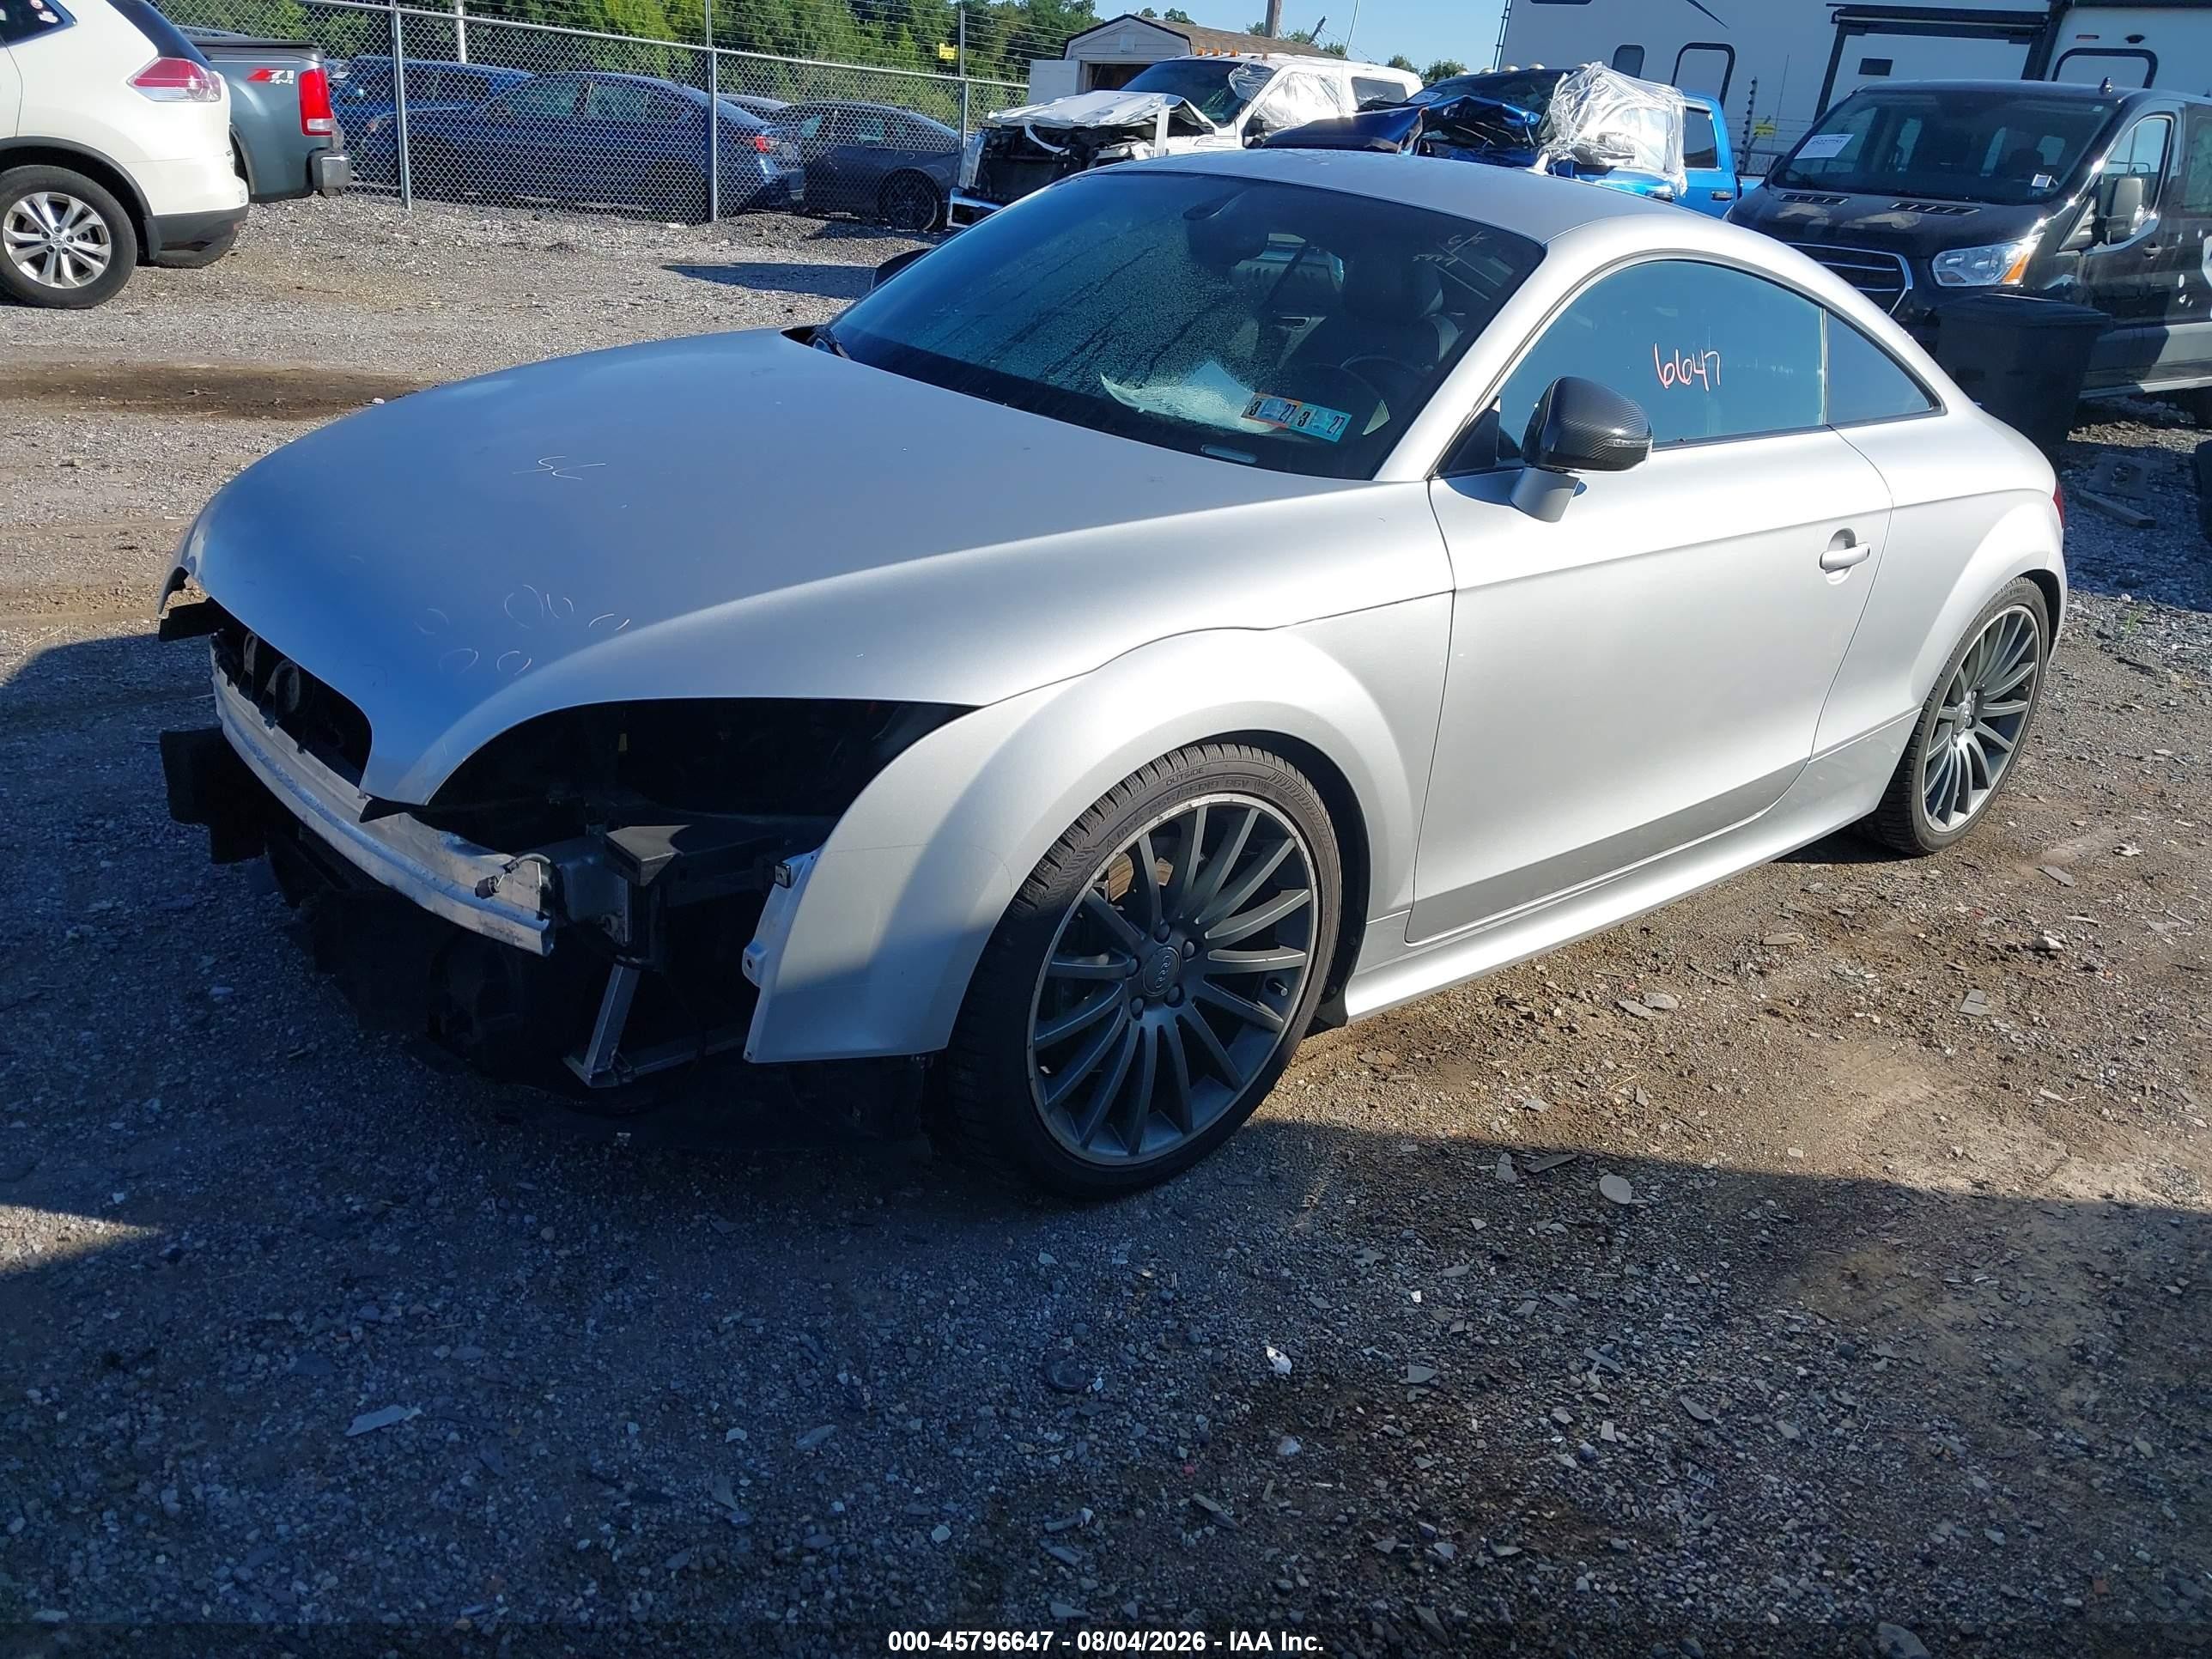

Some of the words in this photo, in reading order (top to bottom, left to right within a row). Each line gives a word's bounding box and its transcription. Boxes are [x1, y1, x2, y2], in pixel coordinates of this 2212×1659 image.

[246, 69, 295, 82] Z71
[1654, 343, 1721, 392] 6647
[1249, 400, 1262, 416] 3
[1277, 404, 1297, 423] 27
[1297, 410, 1311, 428] 3
[1326, 416, 1346, 436] 27
[1166, 767, 1205, 786] OUTSIDE
